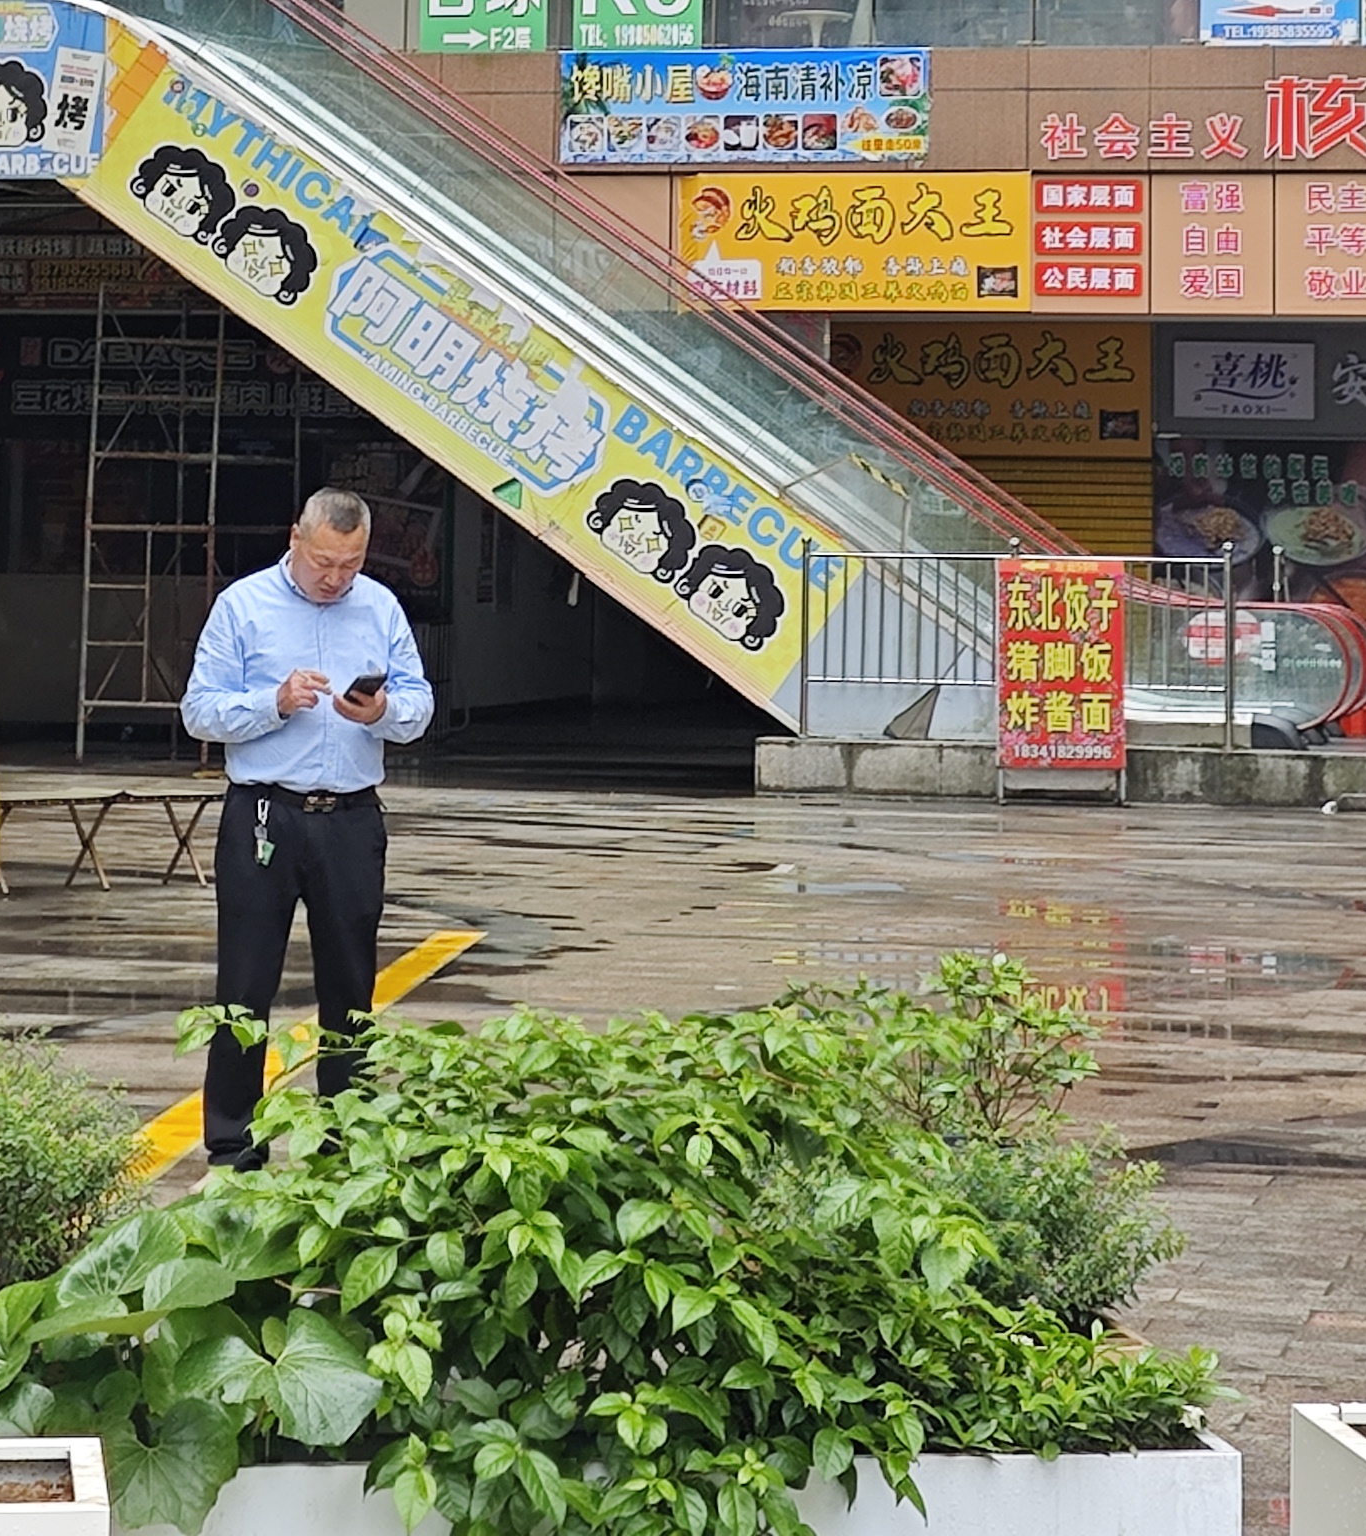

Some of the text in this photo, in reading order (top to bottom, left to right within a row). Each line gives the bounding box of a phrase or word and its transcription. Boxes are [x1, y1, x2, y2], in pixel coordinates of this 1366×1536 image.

[489, 27, 533, 50] F2层
[570, 61, 873, 105] 馋嘴小屋 海南清补凉
[56, 92, 90, 133] 烤
[735, 182, 1014, 246] 火鸡面大王
[1041, 183, 1136, 209] 国家层面
[1180, 181, 1245, 215] 富强
[1041, 225, 1136, 251] 社会层面
[1180, 223, 1245, 257] 自由
[1041, 267, 1136, 293] 公民层面
[1180, 265, 1245, 299] 爱国
[867, 330, 1135, 391] 火鸡面大王
[1205, 351, 1287, 389] 喜桃
[926, 422, 1092, 445] 宗韩国三养火鸡面
[1006, 574, 1119, 633] 东北饺子
[1006, 641, 1114, 683] 猪脚饭
[1006, 692, 1114, 734] 炸酱面
